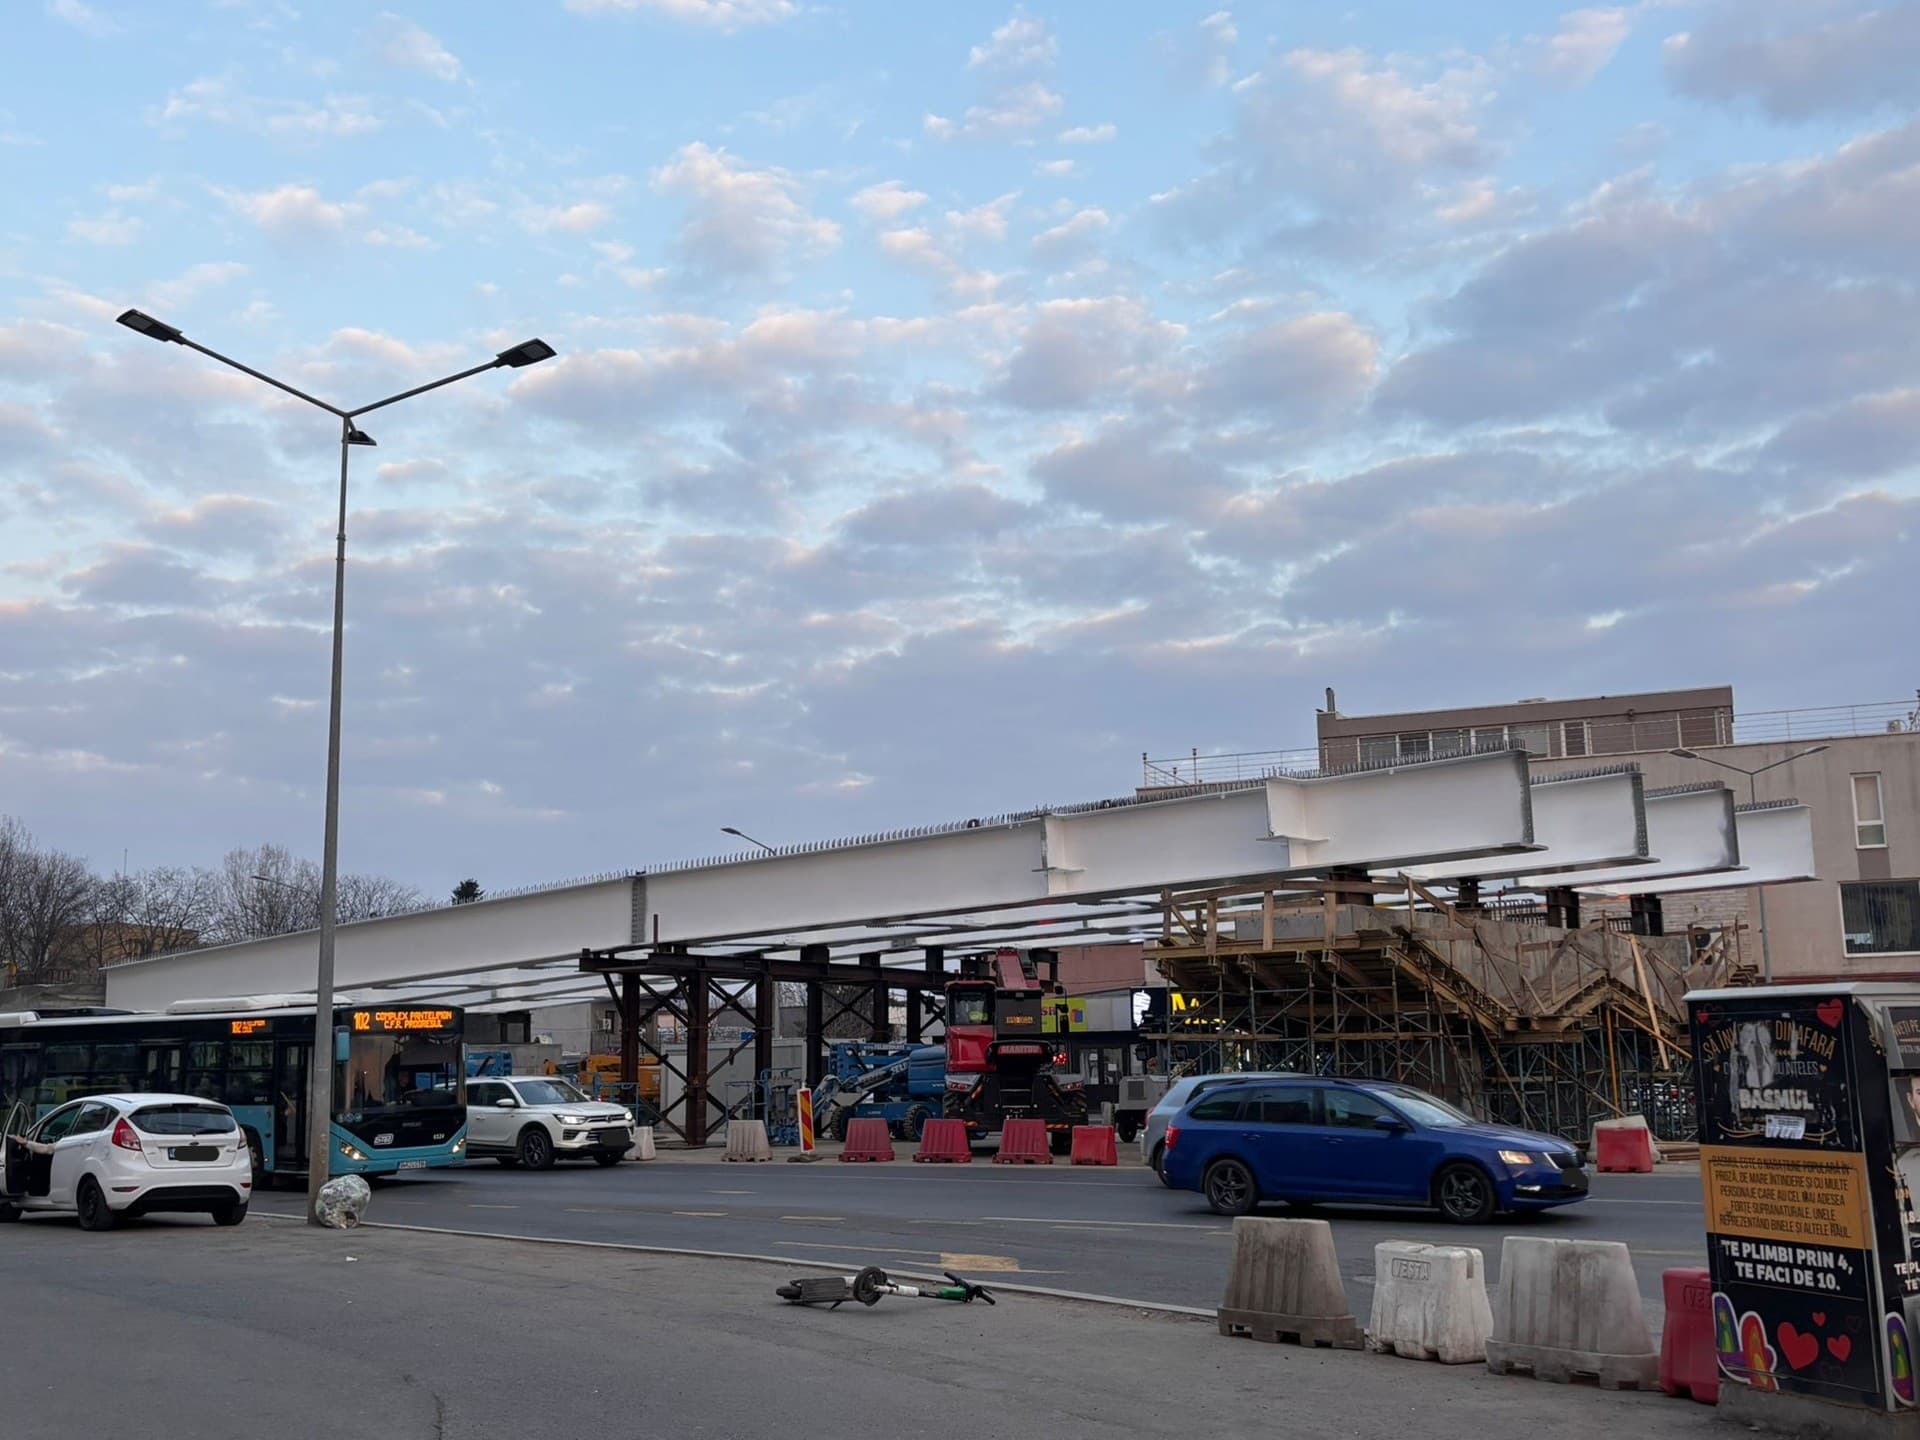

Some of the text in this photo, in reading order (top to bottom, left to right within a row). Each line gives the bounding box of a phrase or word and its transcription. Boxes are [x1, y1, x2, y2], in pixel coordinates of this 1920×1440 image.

[353, 1012, 370, 1030] 102
[375, 1012, 408, 1021] COMPLEX
[1703, 1034, 1722, 1061] SĂ
[1775, 1020, 1796, 1041] DIN
[1796, 1025, 1838, 1060] AFARĂ
[1739, 1088, 1815, 1111] BASMUL
[1739, 1172, 1748, 1183] DE
[1750, 1173, 1768, 1184] MARE
[1770, 1173, 1804, 1186] ÎNTINDERE
[1814, 1178, 1823, 1189] CU
[1825, 1179, 1848, 1191] MULTE
[1720, 1185, 1757, 1198] PERSONAJE
[1758, 1188, 1776, 1199] CARE
[1778, 1190, 1786, 1200] AU
[1788, 1191, 1799, 1201] CEL
[1818, 1193, 1845, 1205] ADESEA
[1814, 1208, 1836, 1221] UNELE
[1771, 1219, 1794, 1232] BINELE
[1804, 1222, 1829, 1236] ALTELE
[1721, 1240, 1853, 1275] TE PLIMBI PRIN 4,
[1393, 1260, 1430, 1280] VESTA
[1735, 1261, 1841, 1291] TE FACI DE 10.
